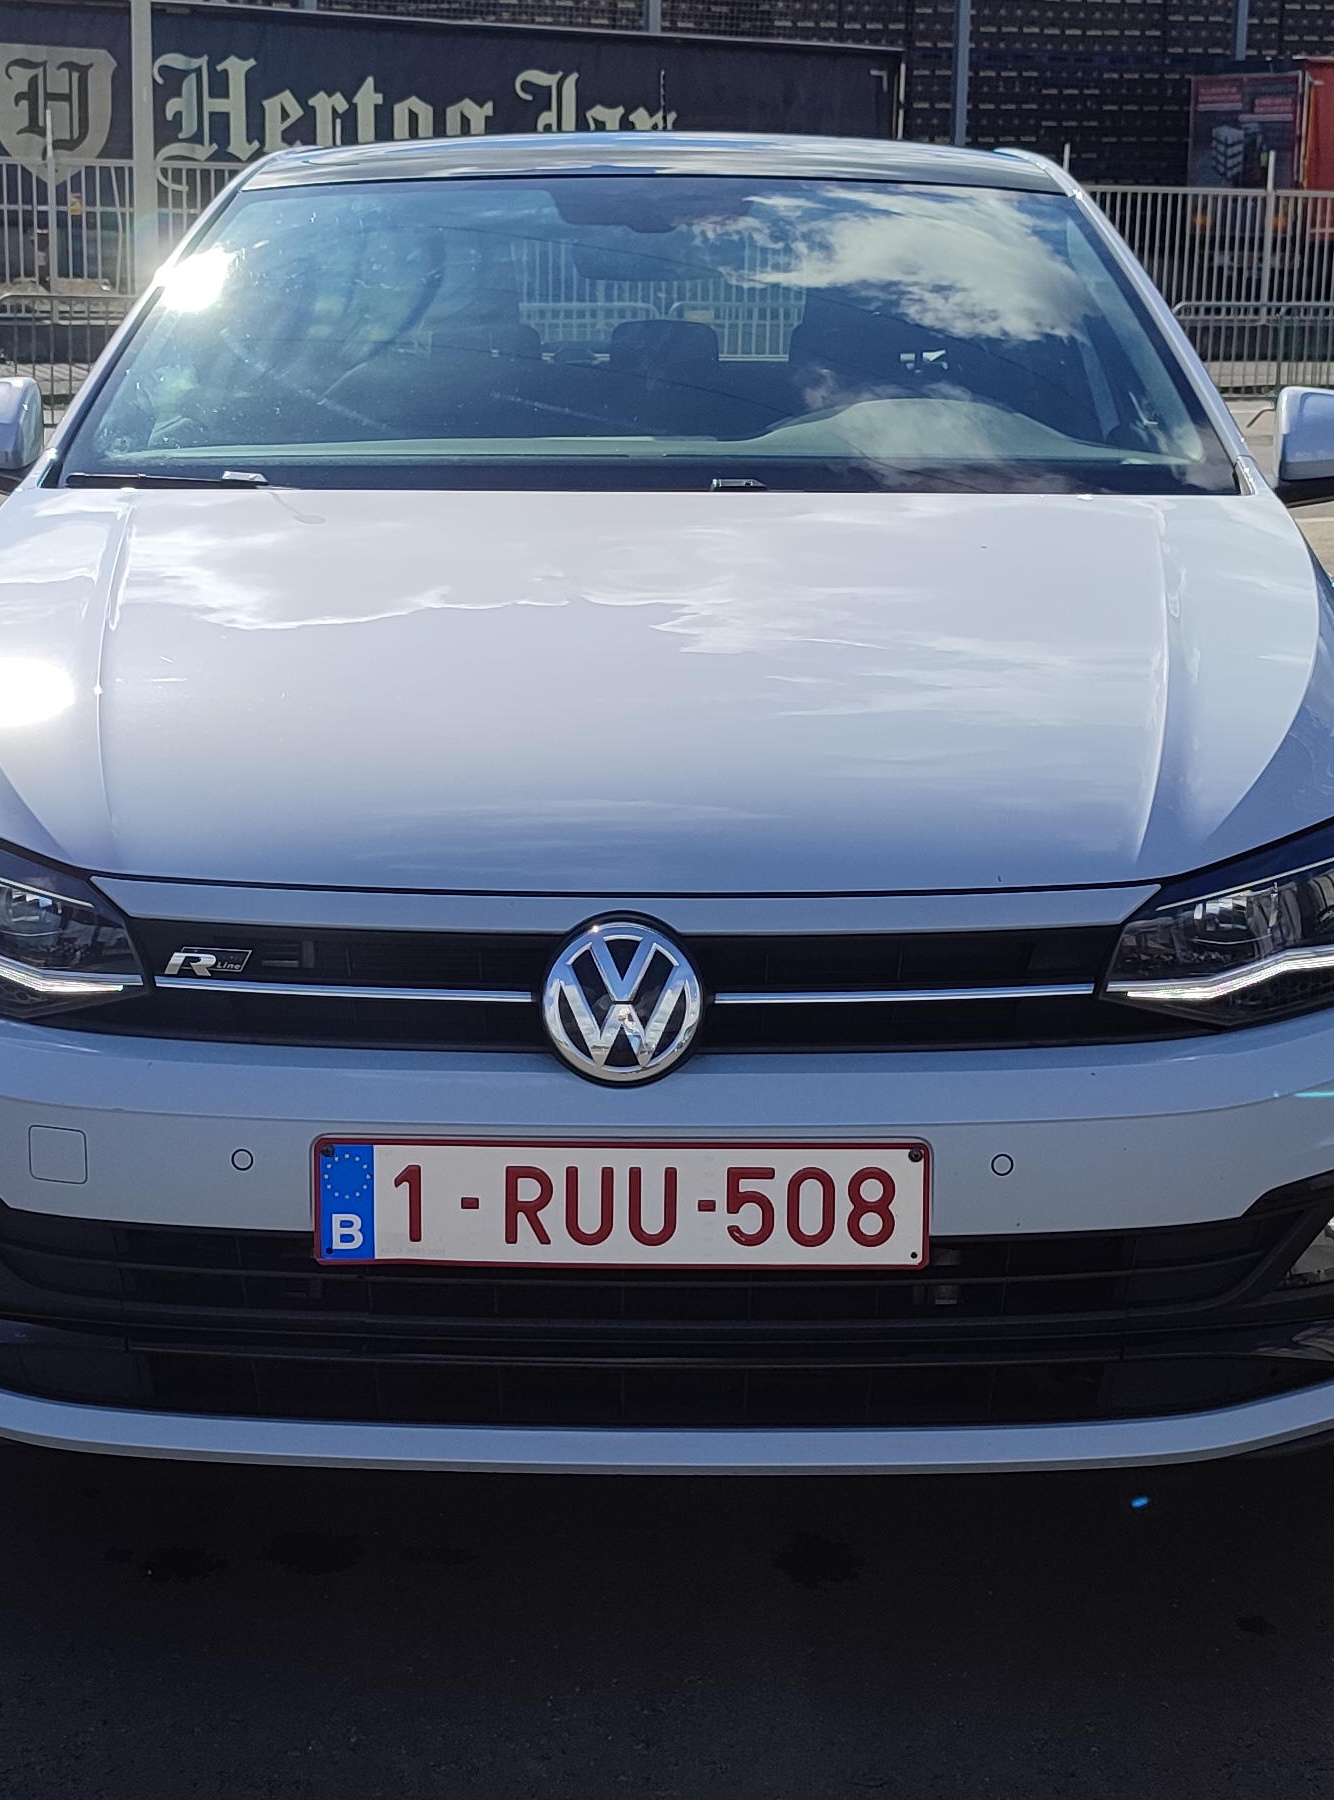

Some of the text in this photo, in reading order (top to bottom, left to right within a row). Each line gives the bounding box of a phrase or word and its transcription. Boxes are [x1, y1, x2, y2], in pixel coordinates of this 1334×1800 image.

[164, 952, 217, 977] R
[332, 1164, 897, 1251] B 1-RUU-508
